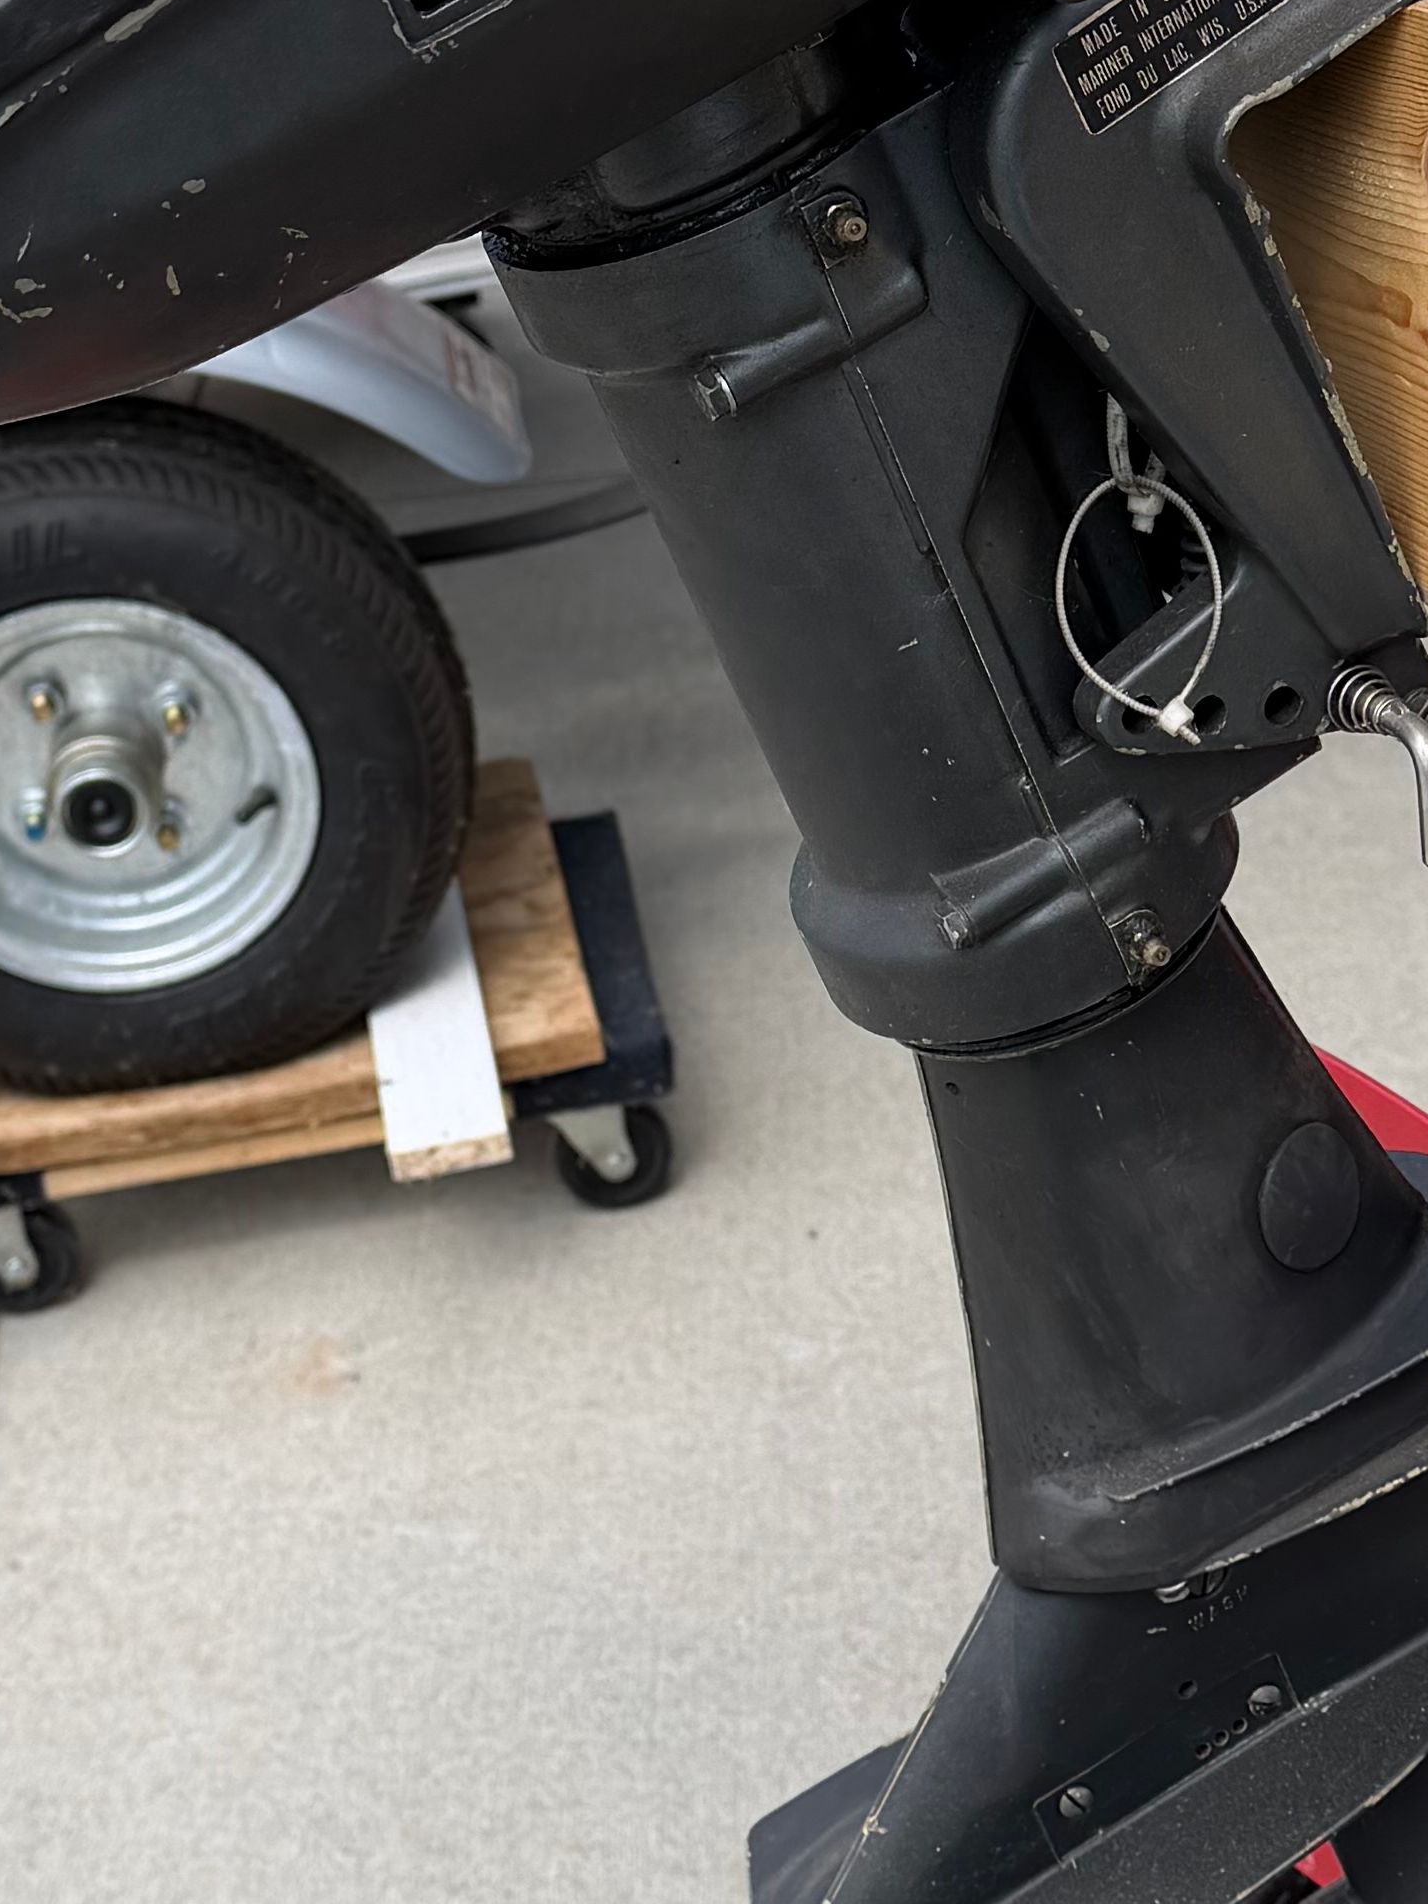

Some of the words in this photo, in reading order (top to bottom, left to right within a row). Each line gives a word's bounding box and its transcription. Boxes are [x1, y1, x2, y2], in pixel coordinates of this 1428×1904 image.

[1080, 16, 1122, 57] MADE
[1077, 45, 1134, 96] MARINER
[1096, 83, 1132, 119] FOND
[1137, 64, 1159, 90] DU
